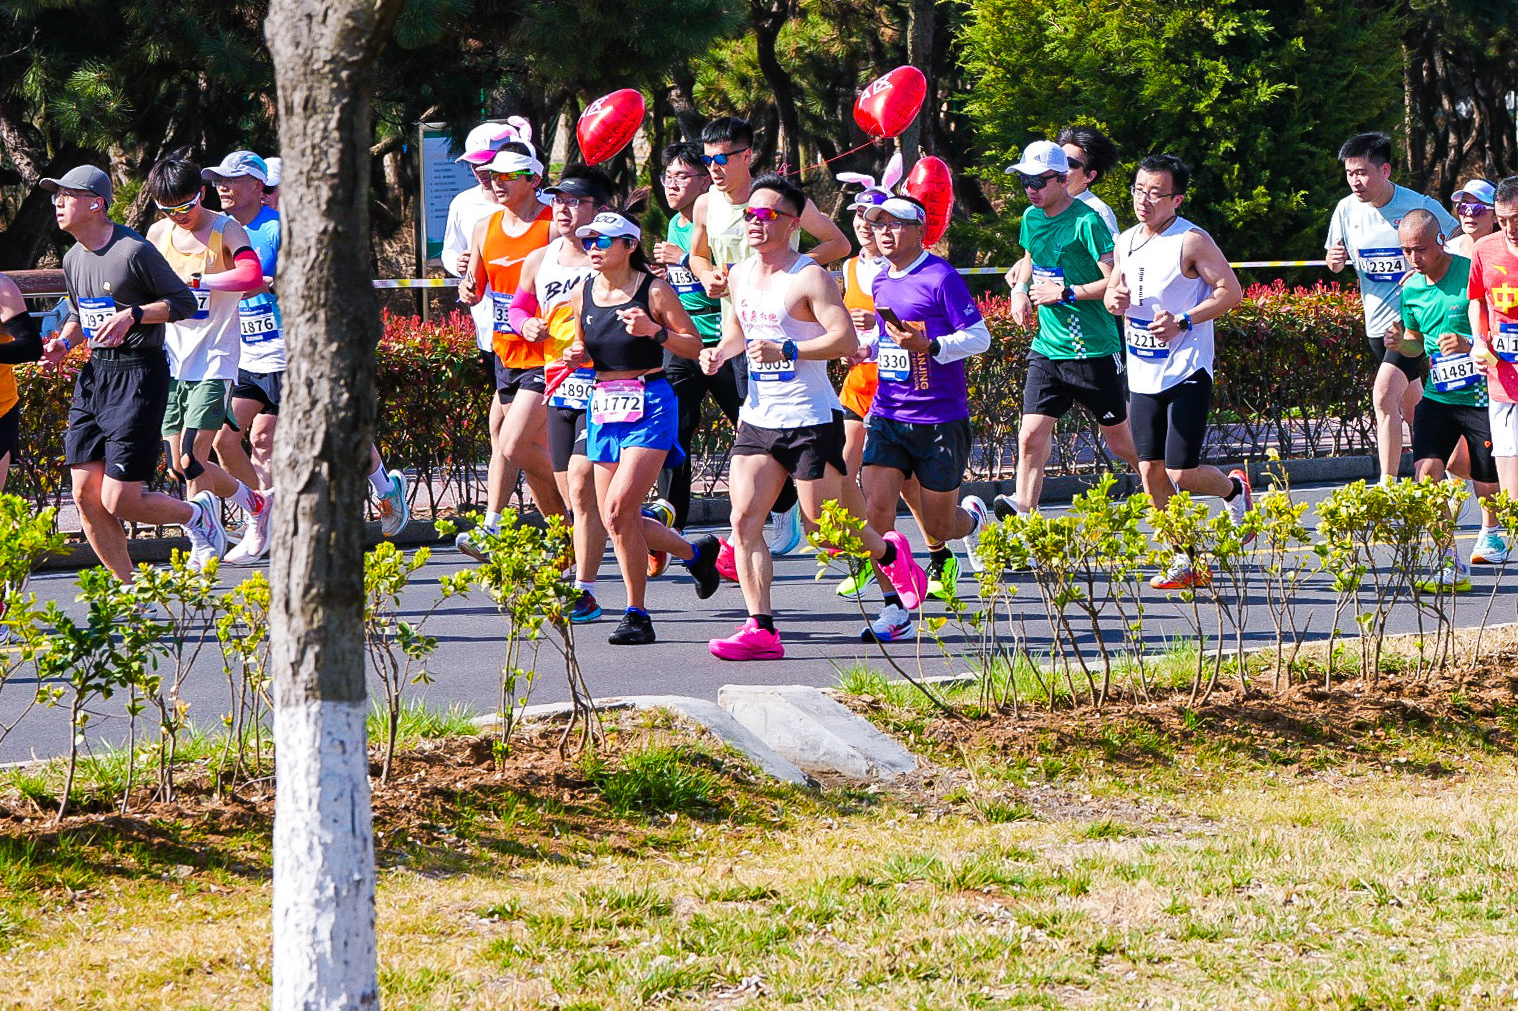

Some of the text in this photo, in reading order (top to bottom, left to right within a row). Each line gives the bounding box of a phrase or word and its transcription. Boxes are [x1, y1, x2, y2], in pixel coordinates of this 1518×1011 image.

[1369, 260, 1403, 273] 2324
[241, 317, 275, 335] 1876
[1126, 332, 1132, 344] A
[1495, 338, 1506, 351] A
[1431, 361, 1475, 383] A 1487
[592, 396, 641, 414] A 1772
